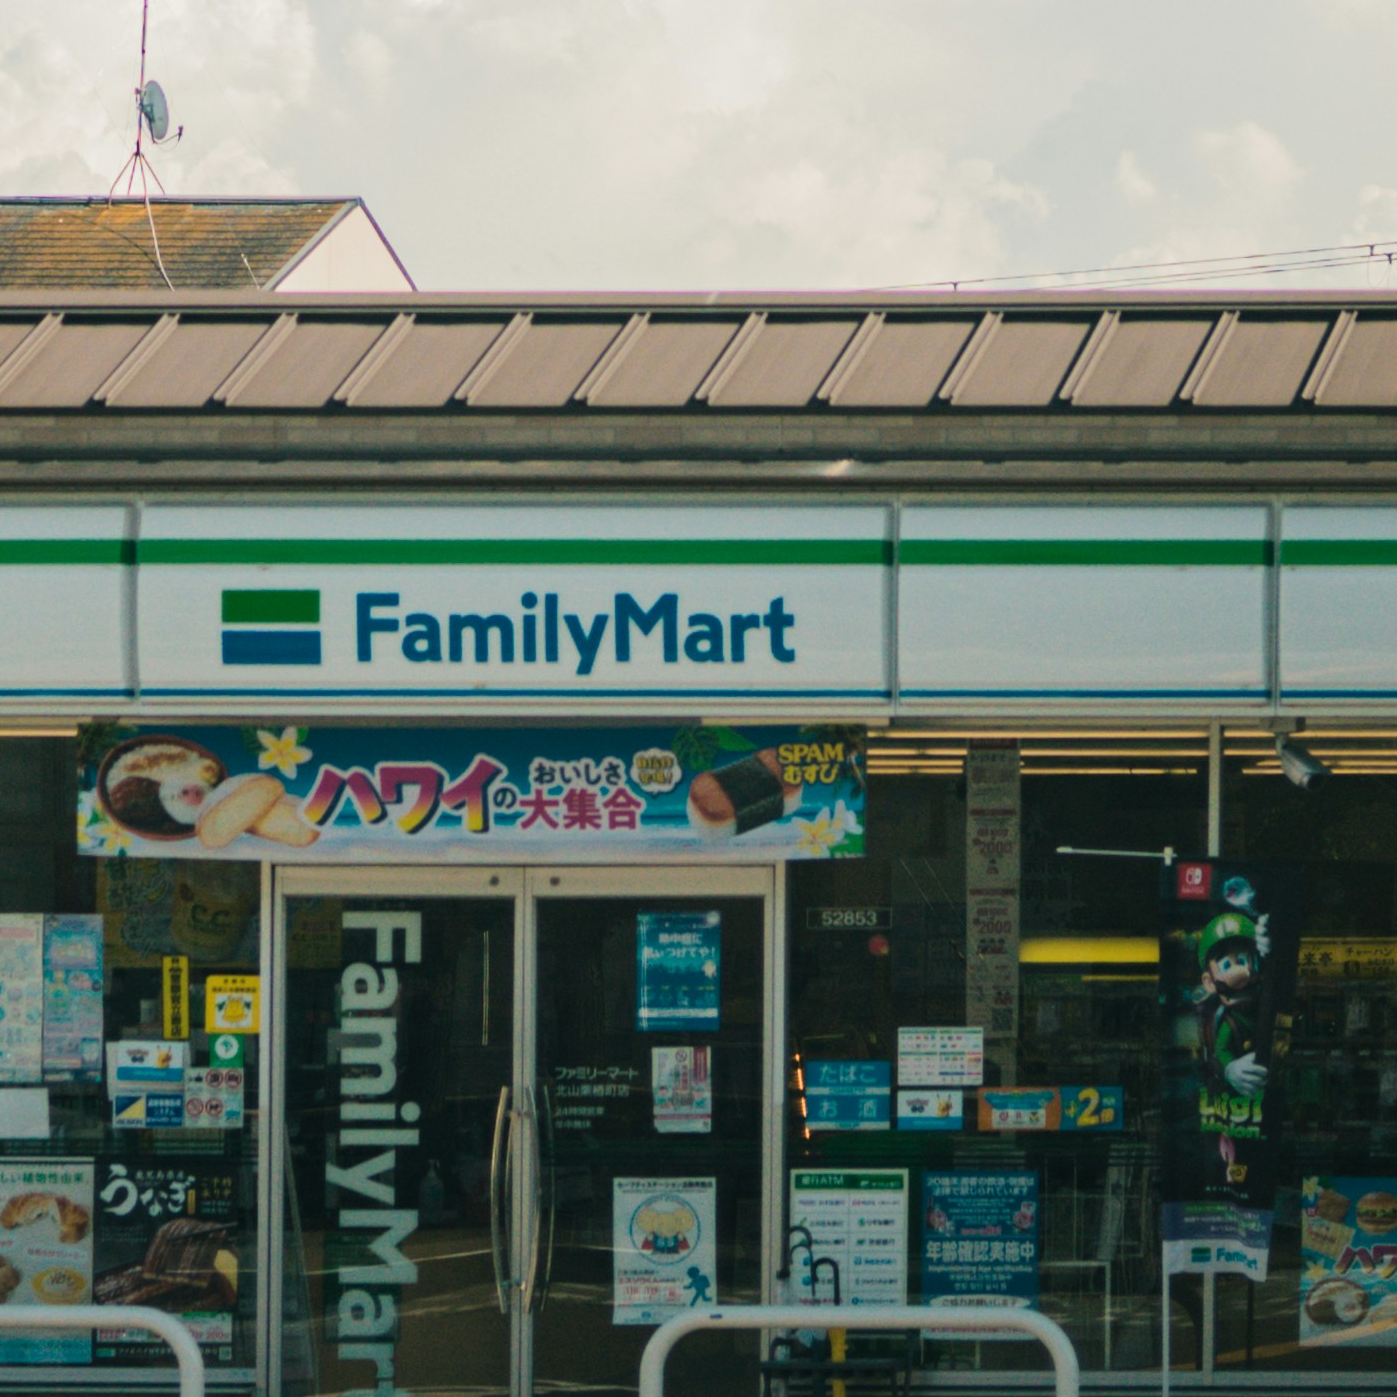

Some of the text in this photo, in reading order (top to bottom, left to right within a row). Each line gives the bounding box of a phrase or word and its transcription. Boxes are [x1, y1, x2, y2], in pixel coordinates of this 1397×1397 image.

[356, 592, 796, 675] FamilyMart
[778, 742, 845, 764] SPAM
[534, 763, 622, 786] おいしさ
[783, 764, 840, 785] むすび
[519, 788, 643, 831] 大集合
[822, 911, 878, 925] 52853
[555, 1066, 639, 1081] ファミリーマート
[820, 1065, 877, 1084] たばこ
[100, 1163, 196, 1217] うなぎ
[926, 1240, 1035, 1263] 年齢確認実施中
